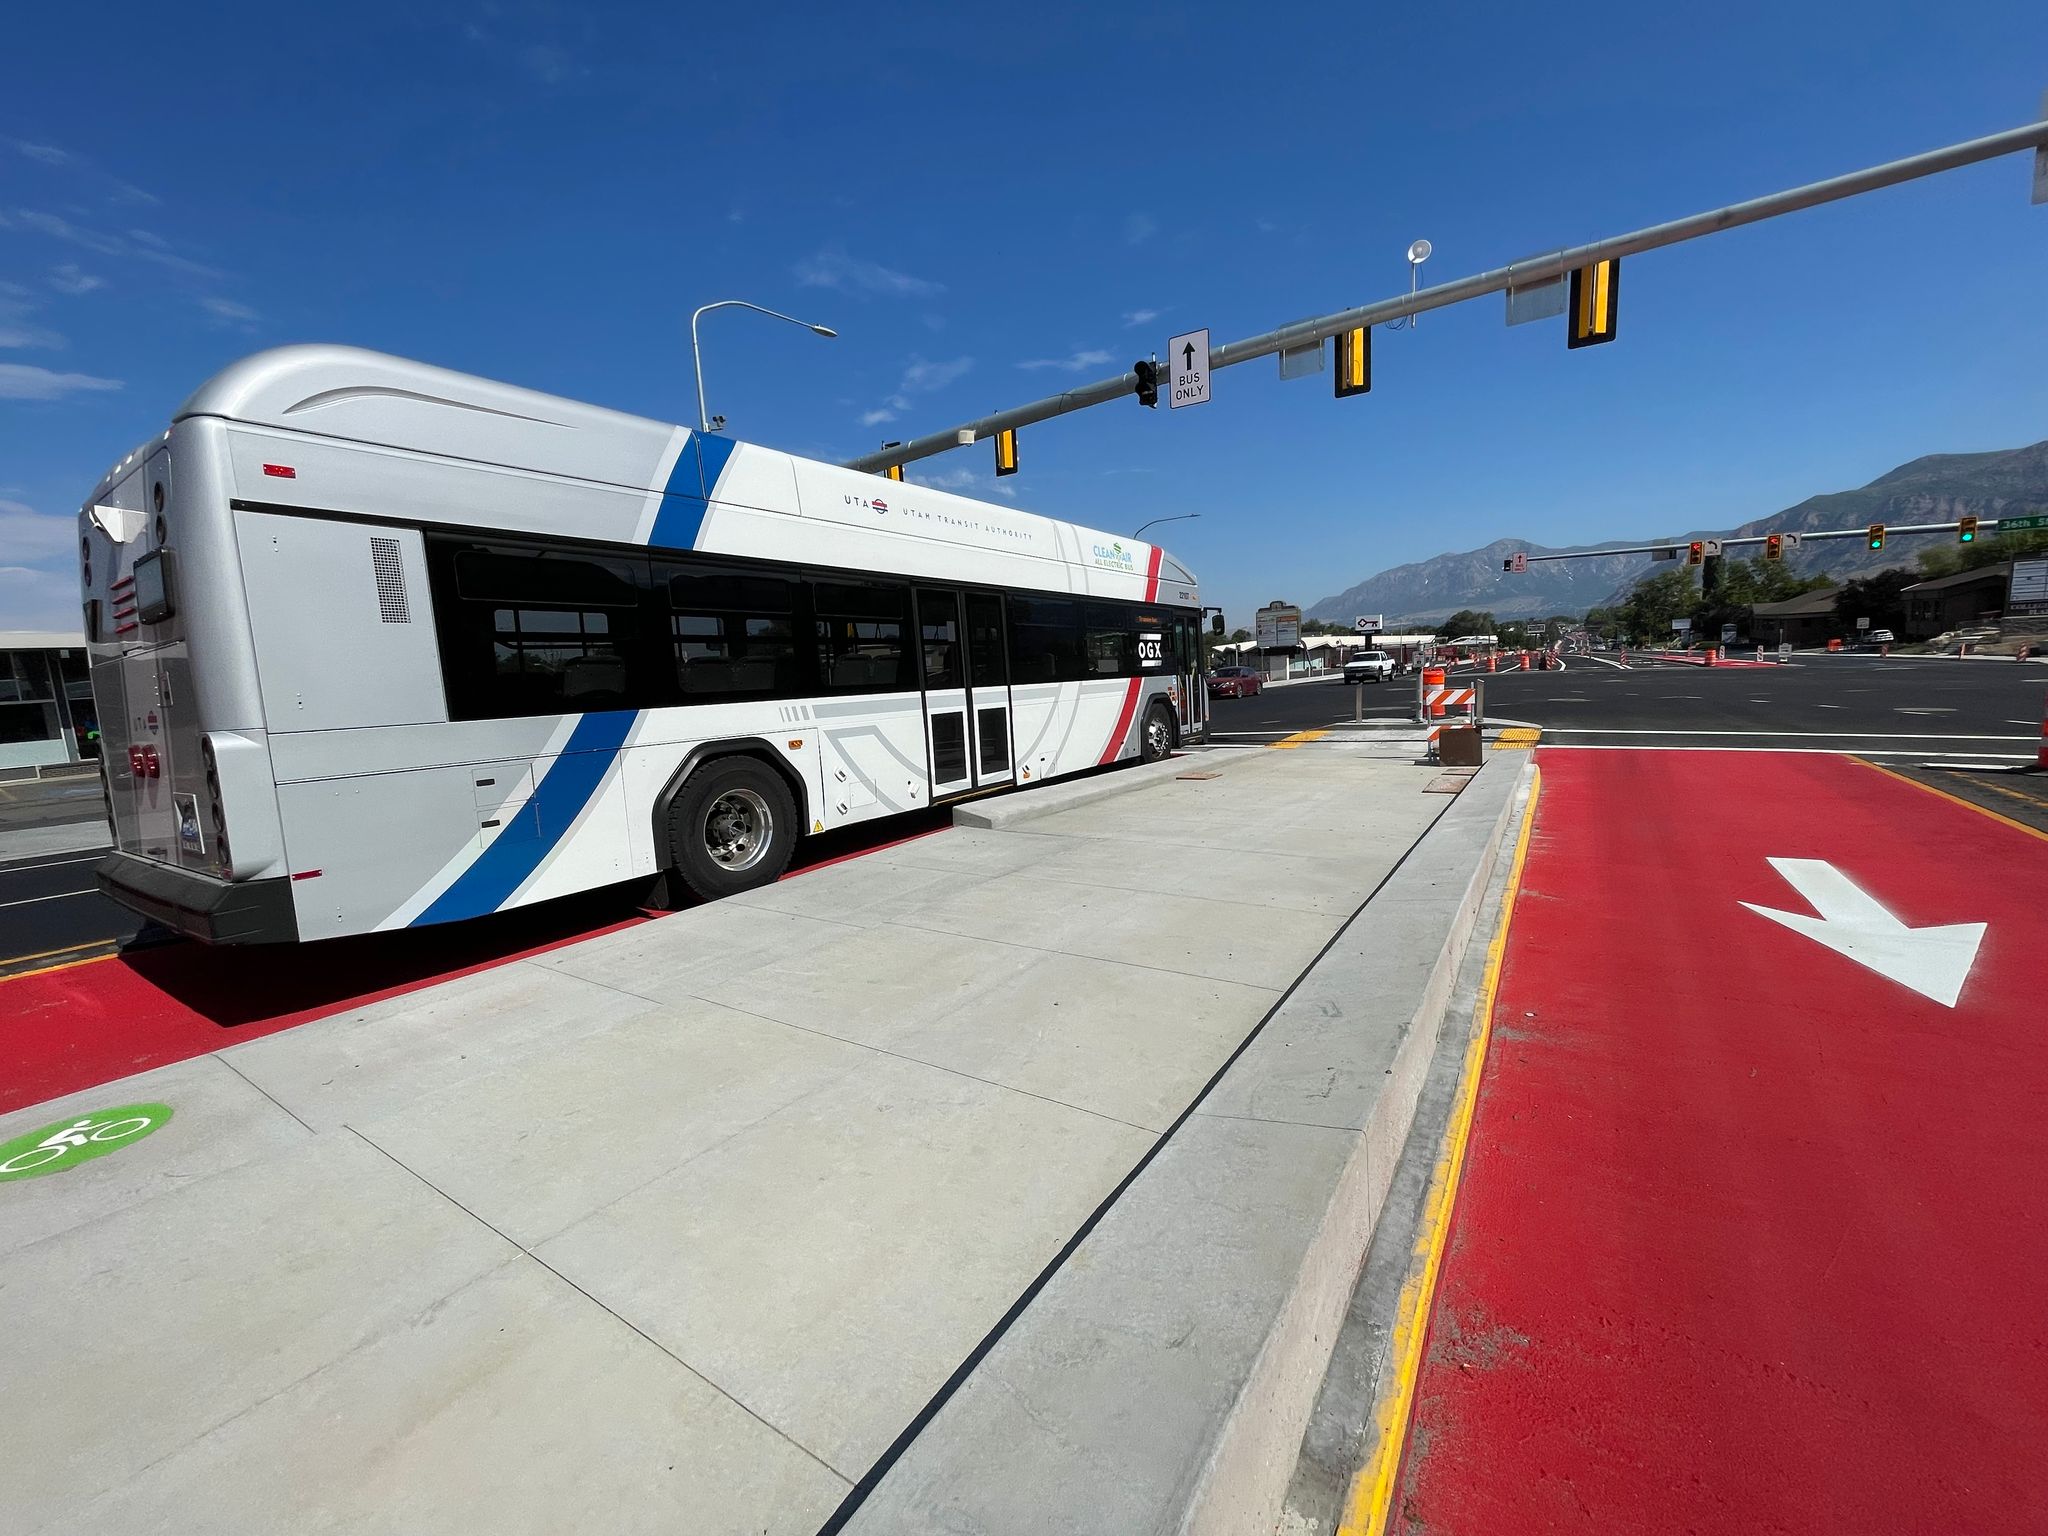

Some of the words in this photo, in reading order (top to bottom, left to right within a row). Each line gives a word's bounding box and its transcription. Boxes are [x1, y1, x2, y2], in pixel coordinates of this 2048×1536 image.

[1179, 372, 1200, 386] BUS
[1175, 384, 1204, 400] ONLY
[844, 494, 869, 508] UTA
[903, 508, 930, 521] UTAH
[937, 514, 979, 530] TRANSIT
[985, 525, 1032, 541] AUTHORITY
[2002, 520, 2031, 529] 36th
[1093, 545, 1115, 559] CLEAN
[1122, 553, 1132, 563] AIR
[1138, 641, 1162, 659] OGX
